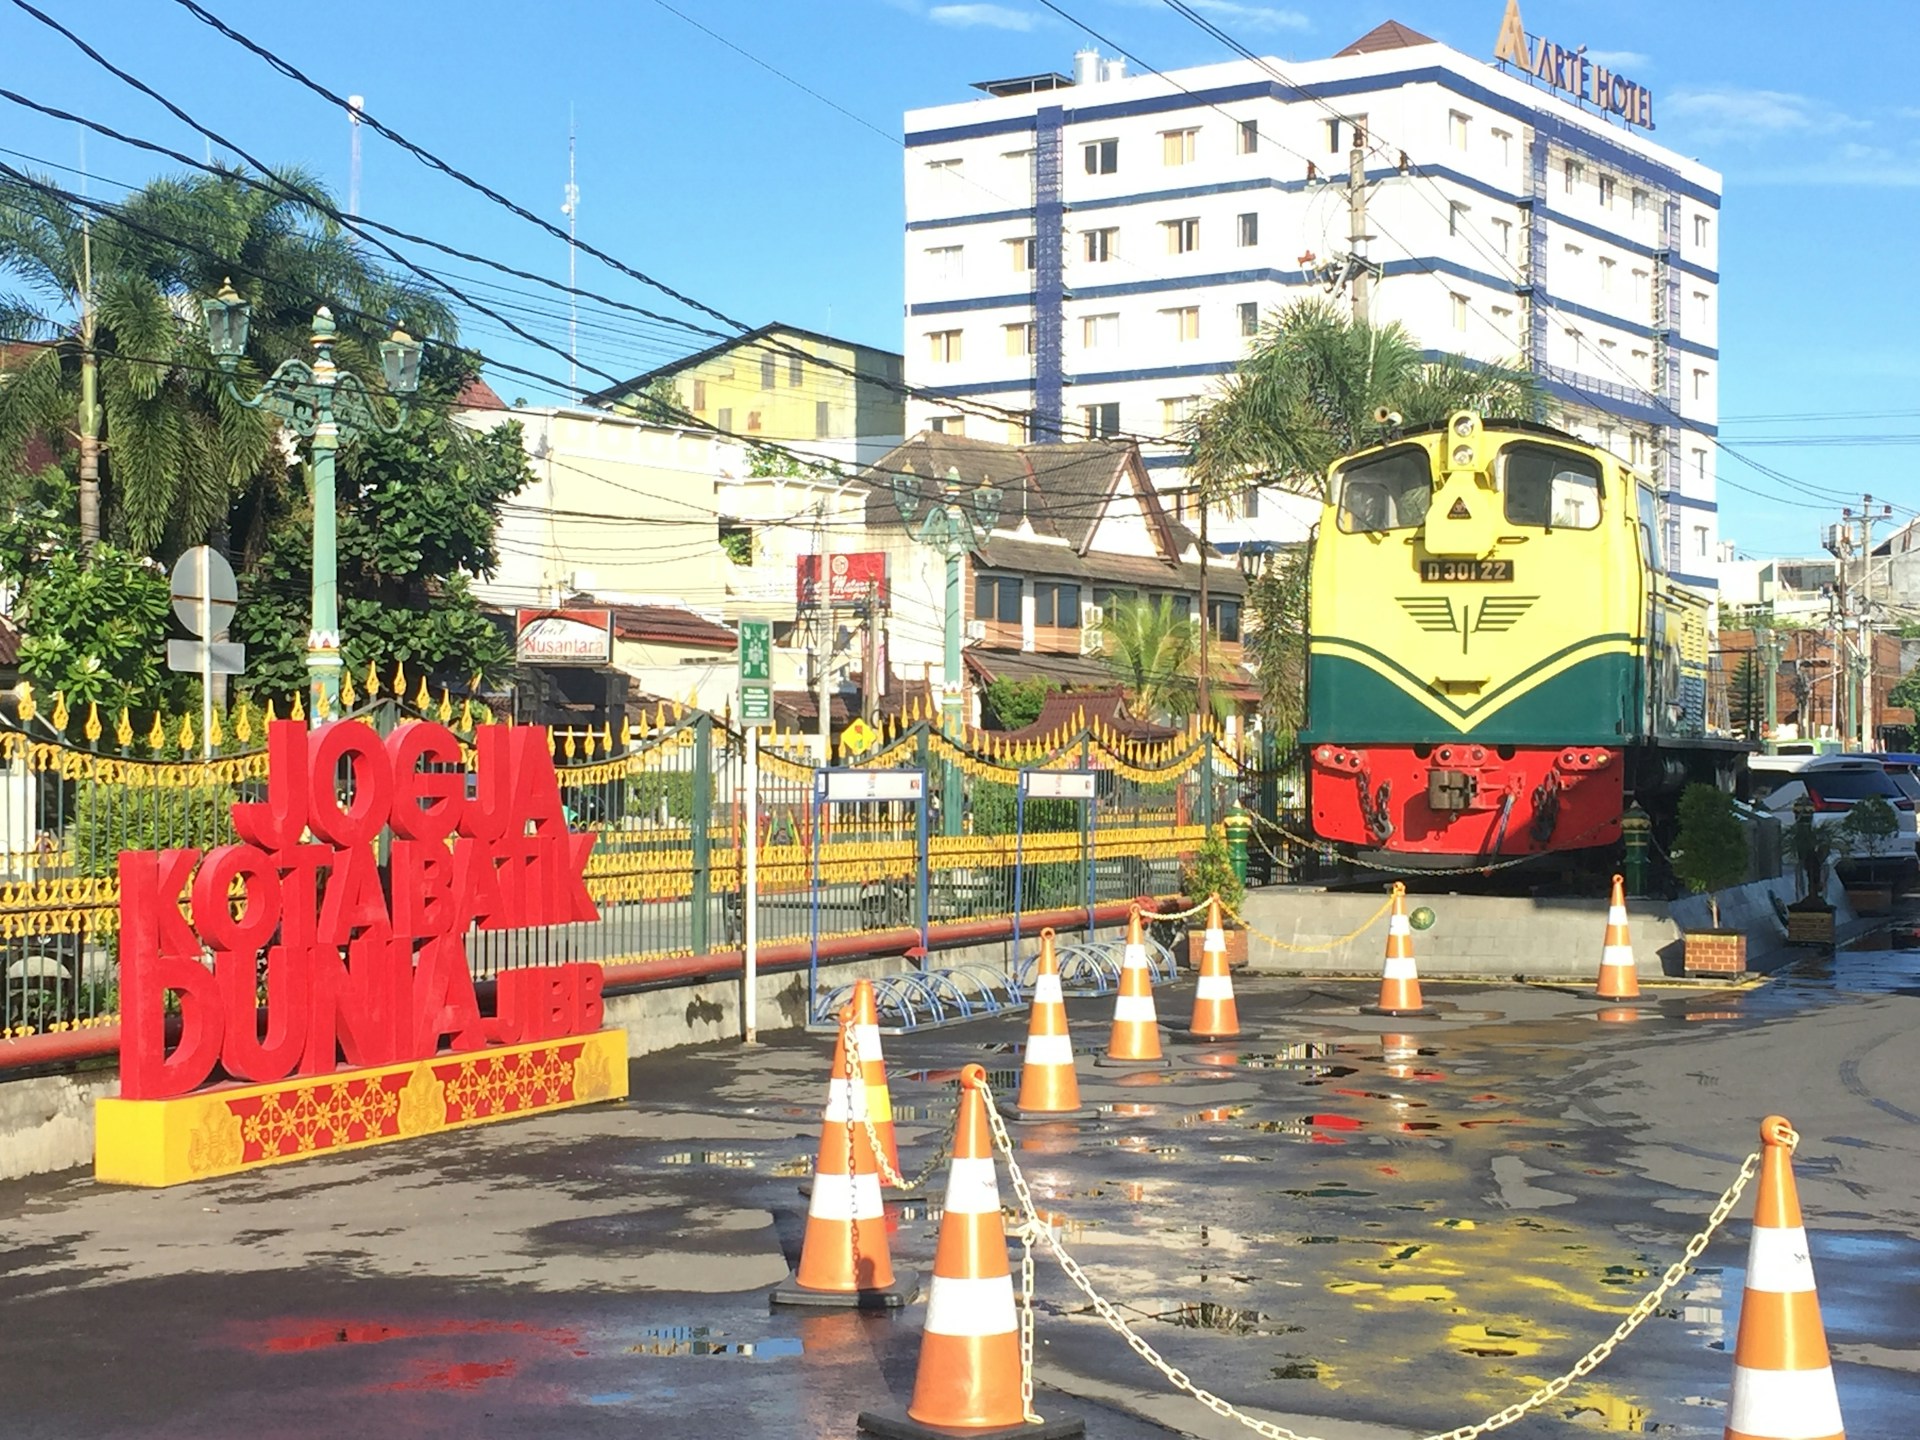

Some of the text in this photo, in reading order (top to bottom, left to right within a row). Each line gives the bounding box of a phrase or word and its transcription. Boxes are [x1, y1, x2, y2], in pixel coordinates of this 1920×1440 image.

[1592, 64, 1656, 130] HOTEL
[1427, 562, 1440, 580] D
[1480, 561, 1507, 580] 22
[524, 636, 605, 654] Nusantara
[232, 719, 568, 851] JOGJA
[119, 833, 601, 957] KOTA BATIK
[119, 932, 487, 1100] DUNIA
